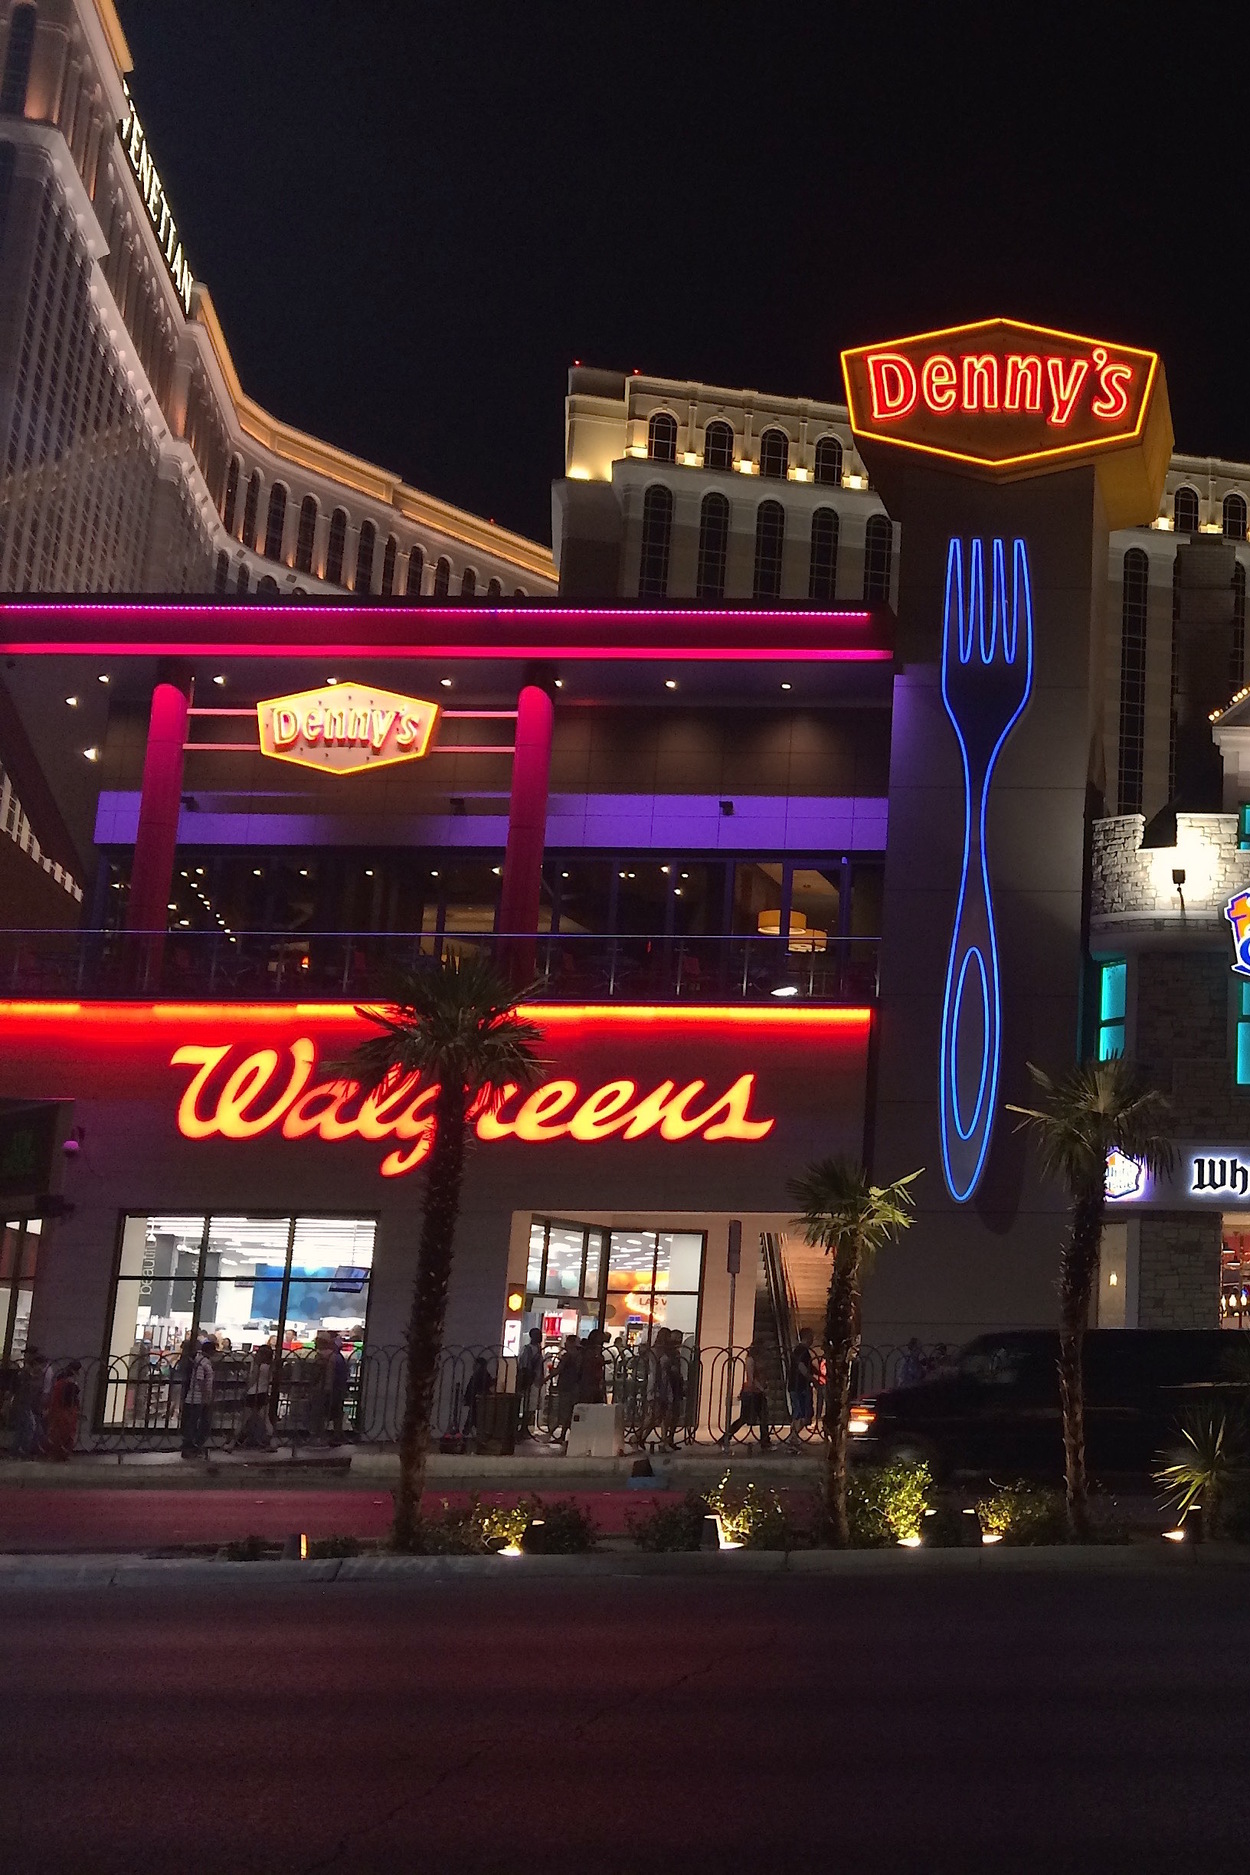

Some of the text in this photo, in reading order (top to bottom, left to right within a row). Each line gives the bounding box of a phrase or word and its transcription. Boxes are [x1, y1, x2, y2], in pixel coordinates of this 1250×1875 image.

[866, 347, 1134, 425] Denny's
[271, 704, 421, 753] Denny's
[170, 1037, 774, 1177] Walgreens
